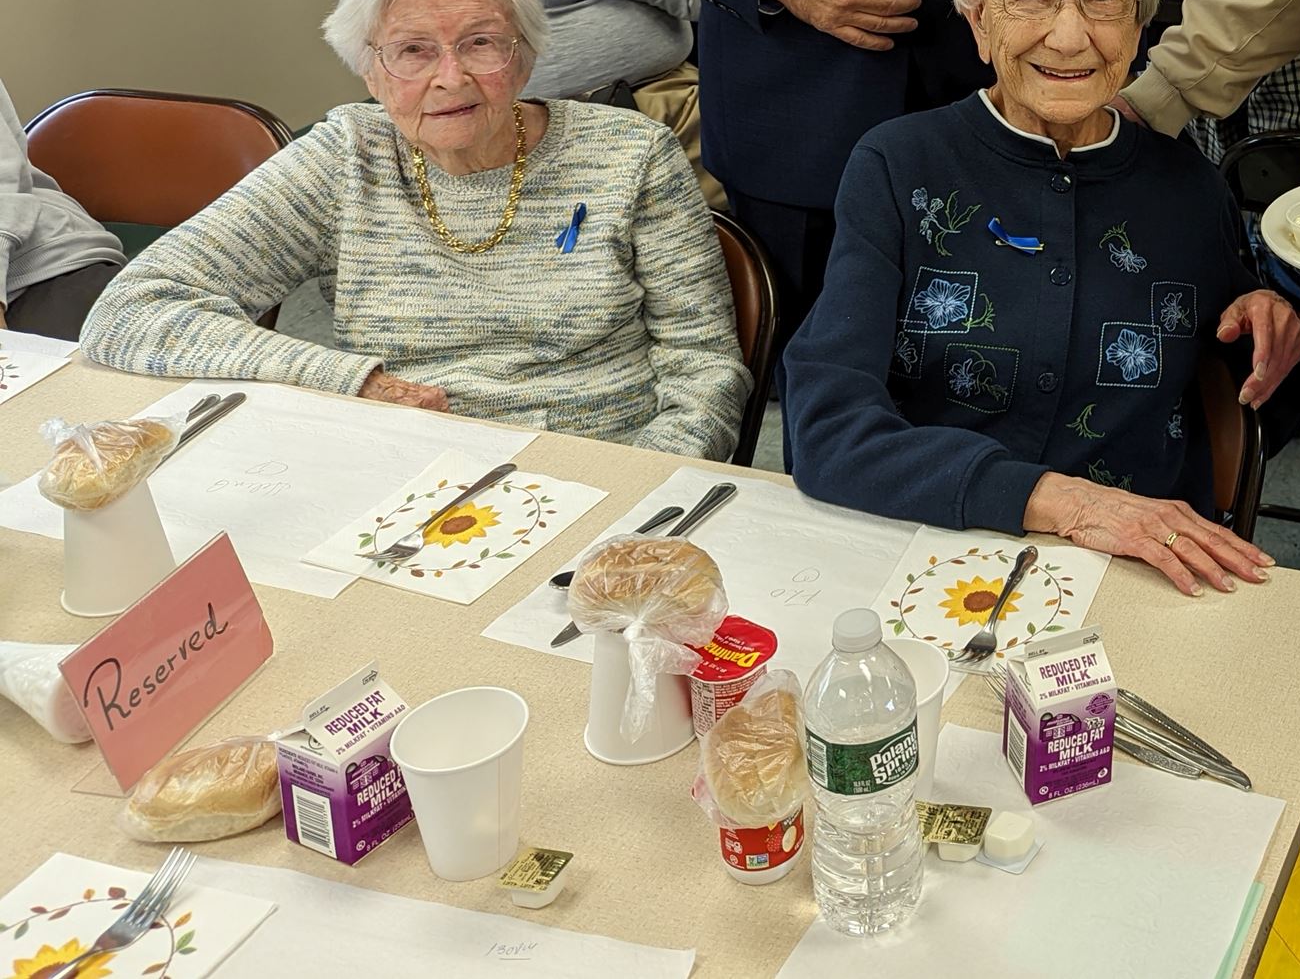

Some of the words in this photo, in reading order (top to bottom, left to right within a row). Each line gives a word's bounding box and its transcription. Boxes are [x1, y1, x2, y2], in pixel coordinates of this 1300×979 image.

[83, 601, 229, 731] Reserved
[703, 641, 761, 667] Danima
[1039, 658, 1081, 679] REDUCED
[1082, 653, 1098, 667] FAT
[1039, 692, 1048, 700] 2%
[1048, 686, 1071, 698] MILKFAT
[1075, 678, 1100, 691] VITAMINS
[1100, 675, 1112, 684] A&D
[1055, 669, 1091, 687] MILK
[324, 702, 370, 736] REDUCED
[365, 690, 386, 708] FAT
[346, 707, 384, 737] MILK
[335, 745, 346, 755] 2%
[344, 732, 367, 750] MILKFAT
[370, 712, 395, 732] VITAMINS
[394, 704, 406, 716] A&D
[1047, 733, 1088, 754] REDUCED
[1089, 727, 1105, 741] FAT
[869, 726, 916, 771] Poland
[873, 740, 917, 785] Spring
[1039, 764, 1048, 772] 2%
[1048, 759, 1071, 770] MILKFAT
[1075, 751, 1099, 763] VITAMINS
[1099, 746, 1111, 755] A&D
[1059, 742, 1093, 760] MILK
[356, 769, 397, 806] REDUCED
[370, 778, 403, 808] MILK
[352, 817, 361, 829] 2%
[360, 803, 383, 823] MILKFAT
